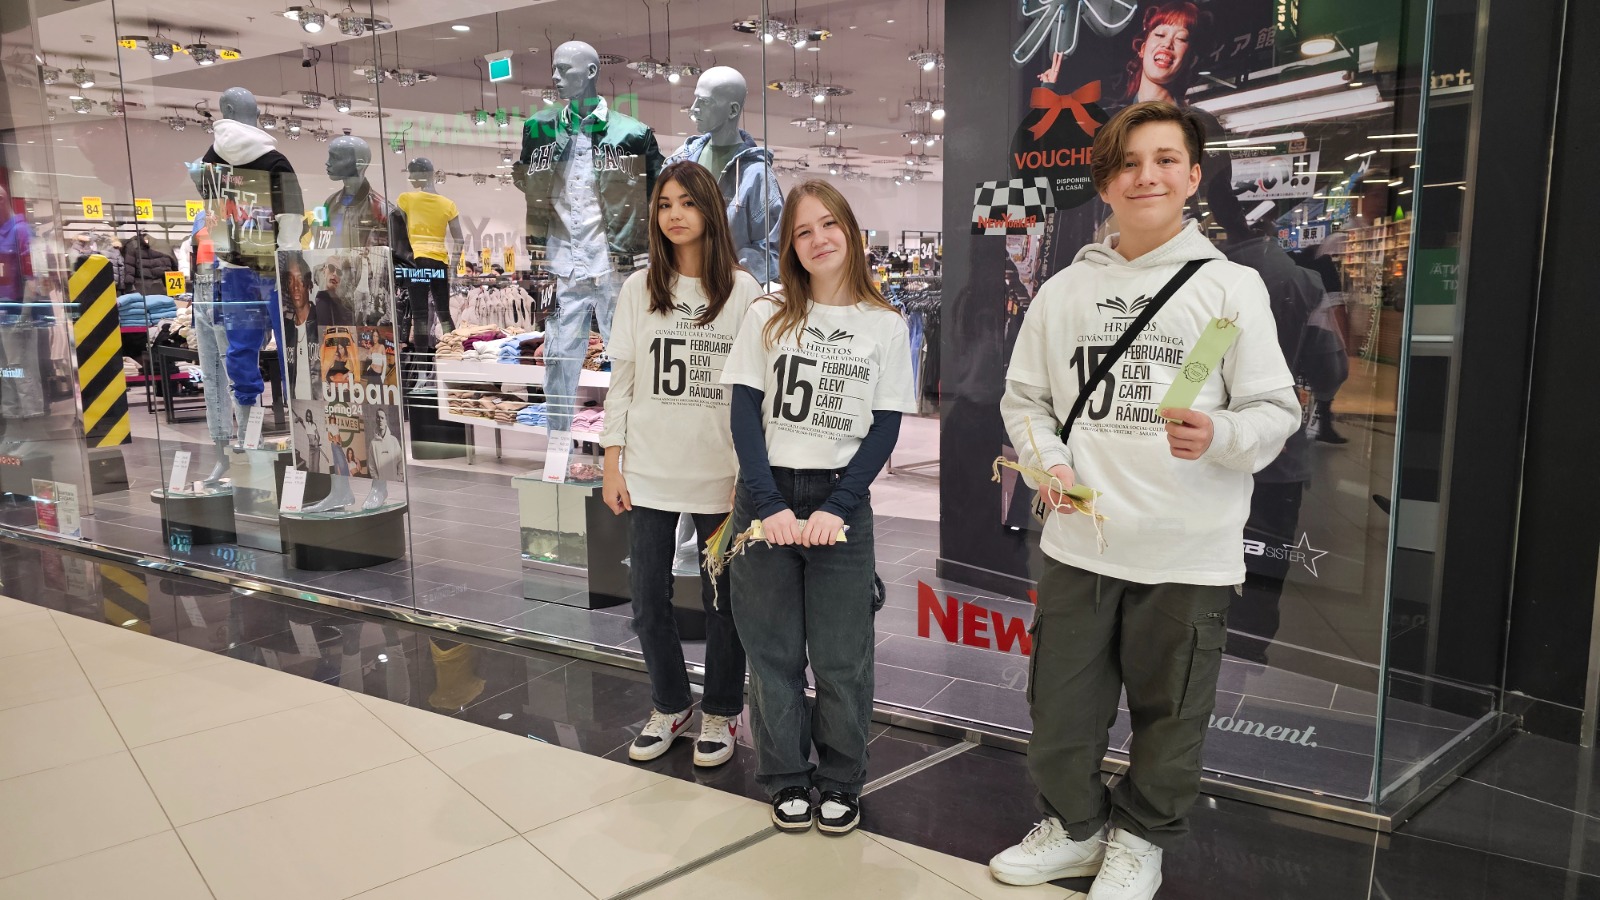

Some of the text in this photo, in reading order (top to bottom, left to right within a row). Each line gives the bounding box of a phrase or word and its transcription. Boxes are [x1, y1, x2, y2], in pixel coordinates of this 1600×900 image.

[1056, 177, 1092, 185] DISPONIBIL
[1104, 321, 1157, 332] HRIOS
[806, 342, 852, 355] HRISTOS
[1124, 344, 1184, 366] FEBRUARIE
[649, 337, 687, 397] 15
[690, 354, 711, 368] ELEVI
[822, 361, 871, 381] FEBRUARIE
[1121, 364, 1151, 381] ELEVI
[322, 373, 400, 406] urban
[689, 383, 724, 401] RÂNDURI
[771, 354, 817, 423] 15
[818, 377, 845, 393] ELEVI
[1069, 345, 1116, 421] 15
[325, 405, 363, 417] spring24
[811, 411, 854, 432] RÂNDURI
[1265, 546, 1306, 564] SISTER
